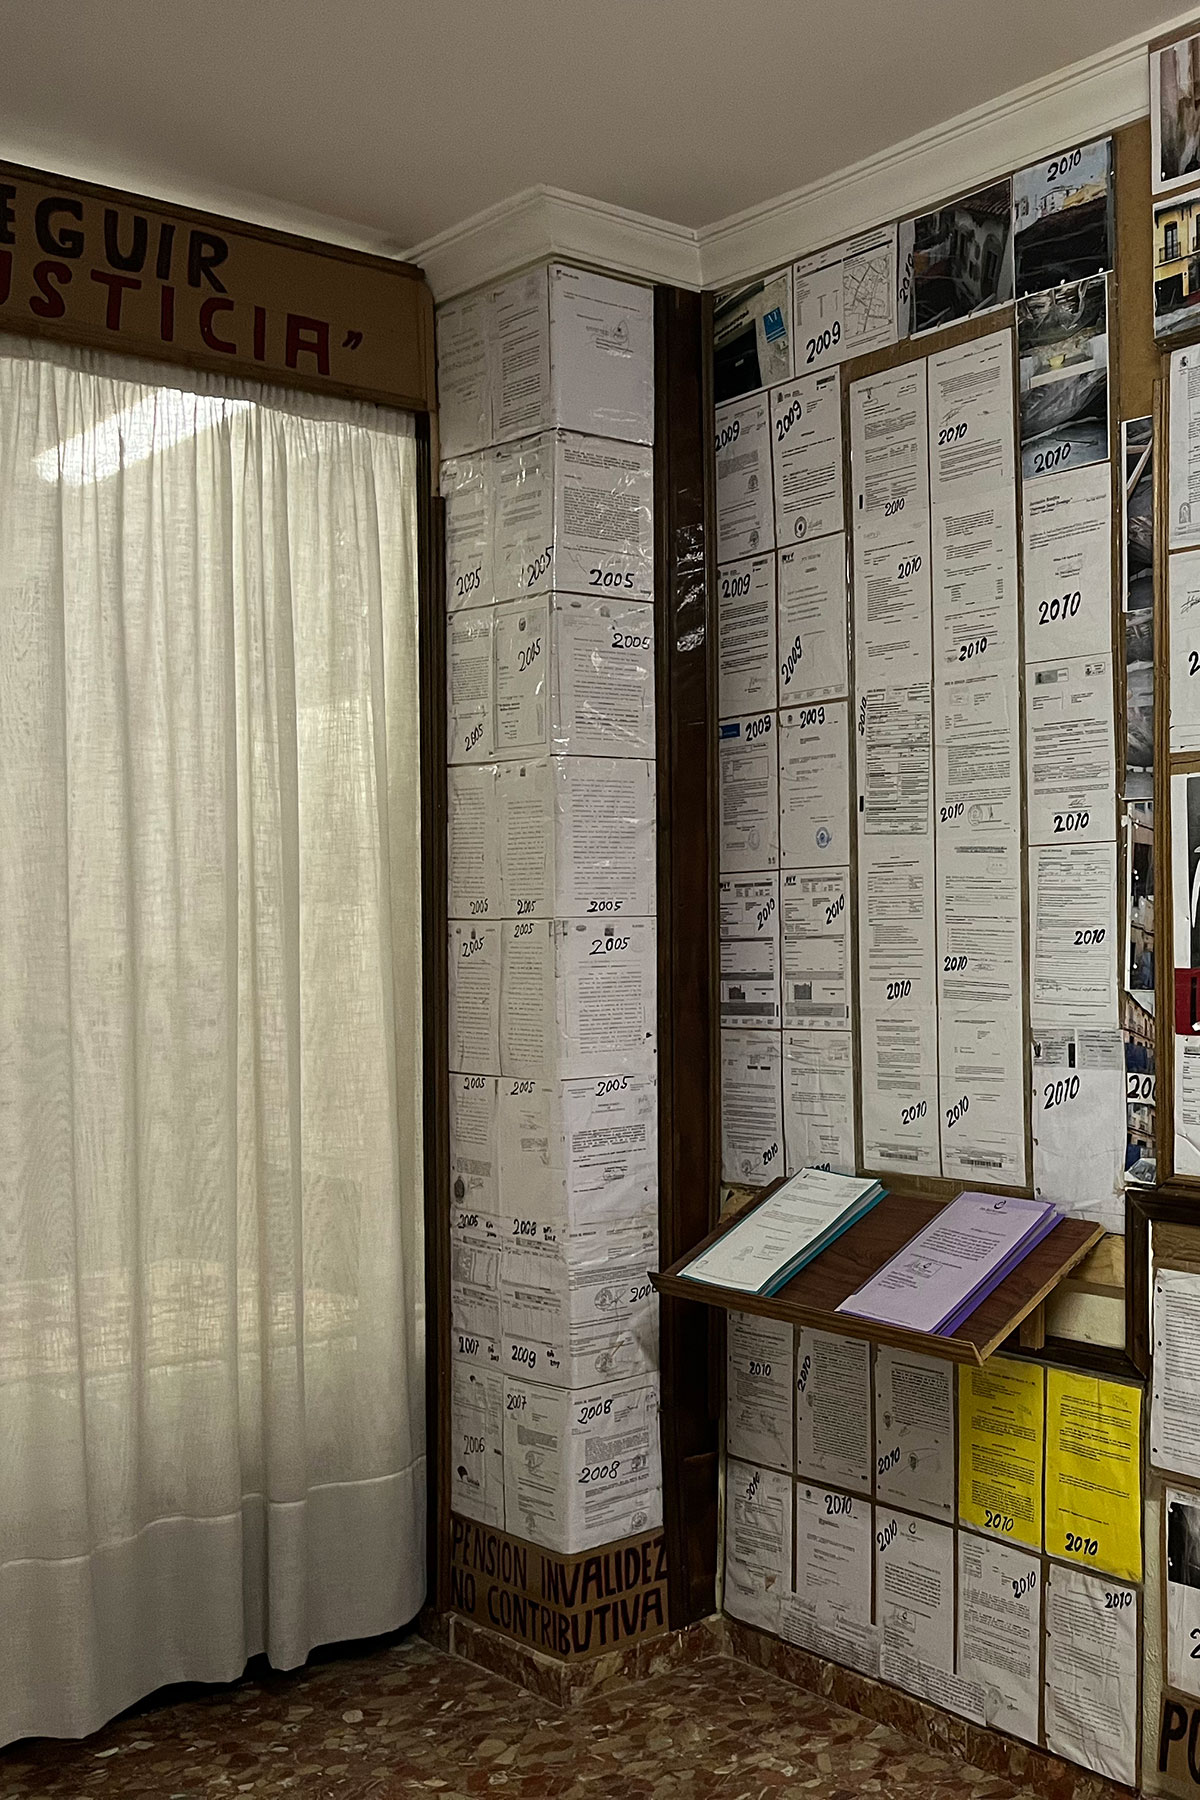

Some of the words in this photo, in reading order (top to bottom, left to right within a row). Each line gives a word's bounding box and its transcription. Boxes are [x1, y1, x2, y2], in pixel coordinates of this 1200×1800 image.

[1047, 149, 1081, 182] 2010
[806, 321, 840, 364] 2009
[776, 400, 802, 441] 2009
[938, 422, 968, 446] 2010
[1033, 442, 1071, 473] 2010
[884, 497, 905, 517] 2010
[897, 556, 922, 580] 2010
[721, 573, 751, 598] 2009
[1038, 591, 1081, 625] 2010
[781, 635, 803, 685] 2009
[958, 636, 988, 661] 2010
[745, 714, 772, 741] 2009
[799, 706, 826, 728] 2009
[940, 802, 964, 822] 2010
[1053, 812, 1090, 833] 2010
[757, 898, 776, 930] 2010
[825, 893, 845, 926] 2010
[1073, 928, 1106, 946] 2010
[943, 955, 968, 972] 2010
[886, 979, 911, 1000] 2010
[1043, 1075, 1080, 1110] 2010
[901, 1100, 927, 1126] 2010
[946, 1095, 970, 1128] 2010
[762, 1142, 778, 1166] 2010
[459, 1336, 479, 1355] 2007
[511, 1345, 536, 1368] 2009
[749, 1361, 772, 1377] 2010
[507, 1394, 527, 1410] 2007
[577, 1399, 613, 1424] 2008
[463, 1435, 485, 1455] 2006
[578, 1461, 620, 1483] 2008
[877, 1446, 901, 1475] 2010
[824, 1494, 852, 1516] 2010
[984, 1510, 1014, 1533] 2010
[877, 1519, 898, 1552] 2010
[1065, 1532, 1099, 1557] 2010
[451, 1518, 527, 1592] PENSION
[541, 1534, 669, 1608] INVALIDEZ
[1012, 1571, 1037, 1599] 2010
[451, 1566, 476, 1614] NO
[487, 1587, 664, 1656] CONTRIBUTIVA
[1103, 1591, 1133, 1610] 2010
